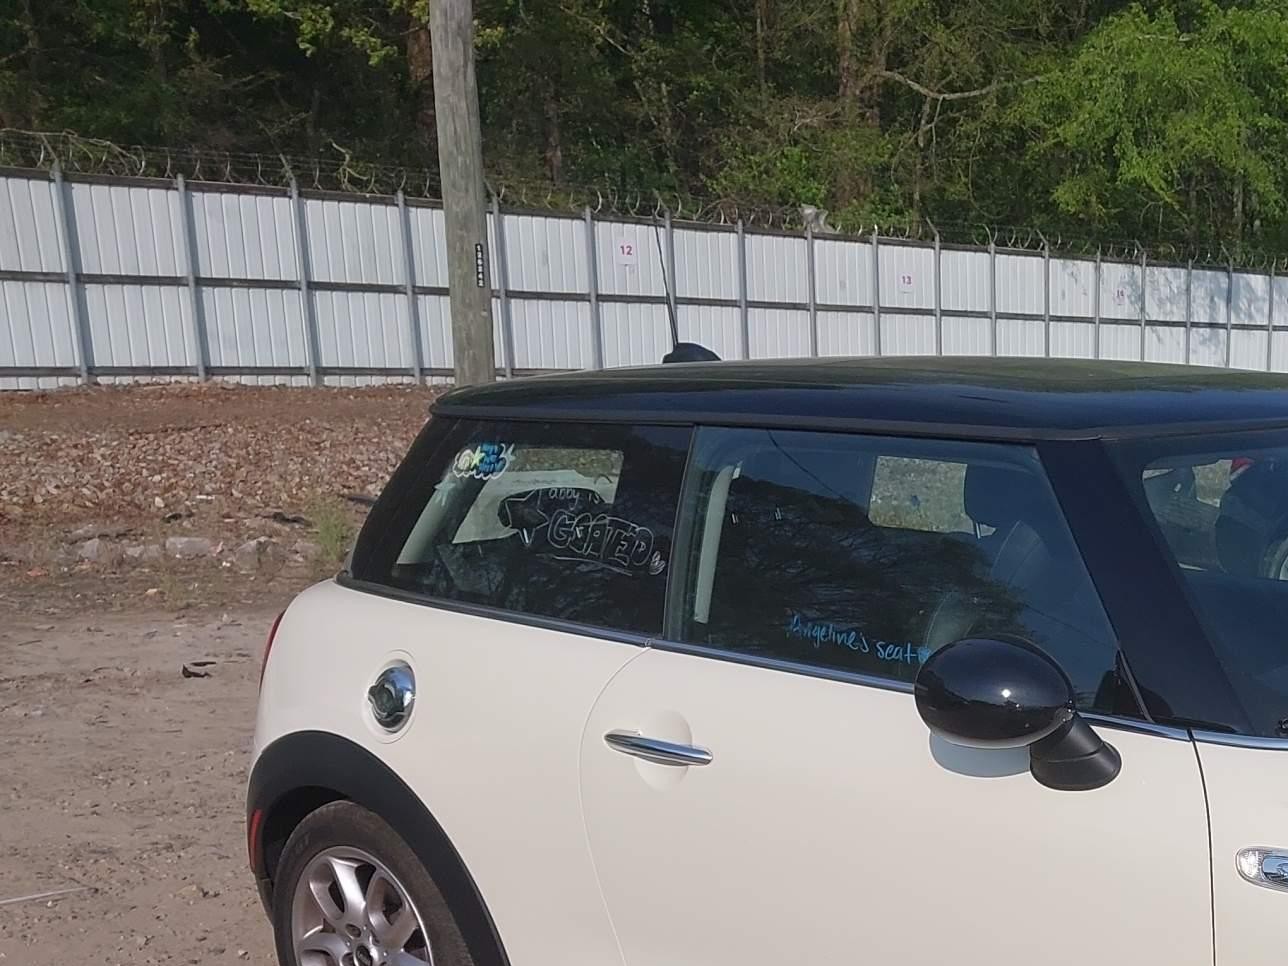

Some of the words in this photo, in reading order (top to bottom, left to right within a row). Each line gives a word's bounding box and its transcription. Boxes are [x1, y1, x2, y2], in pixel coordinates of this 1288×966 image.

[620, 245, 633, 256] 12
[902, 275, 912, 285] 13
[876, 641, 917, 665] seat
